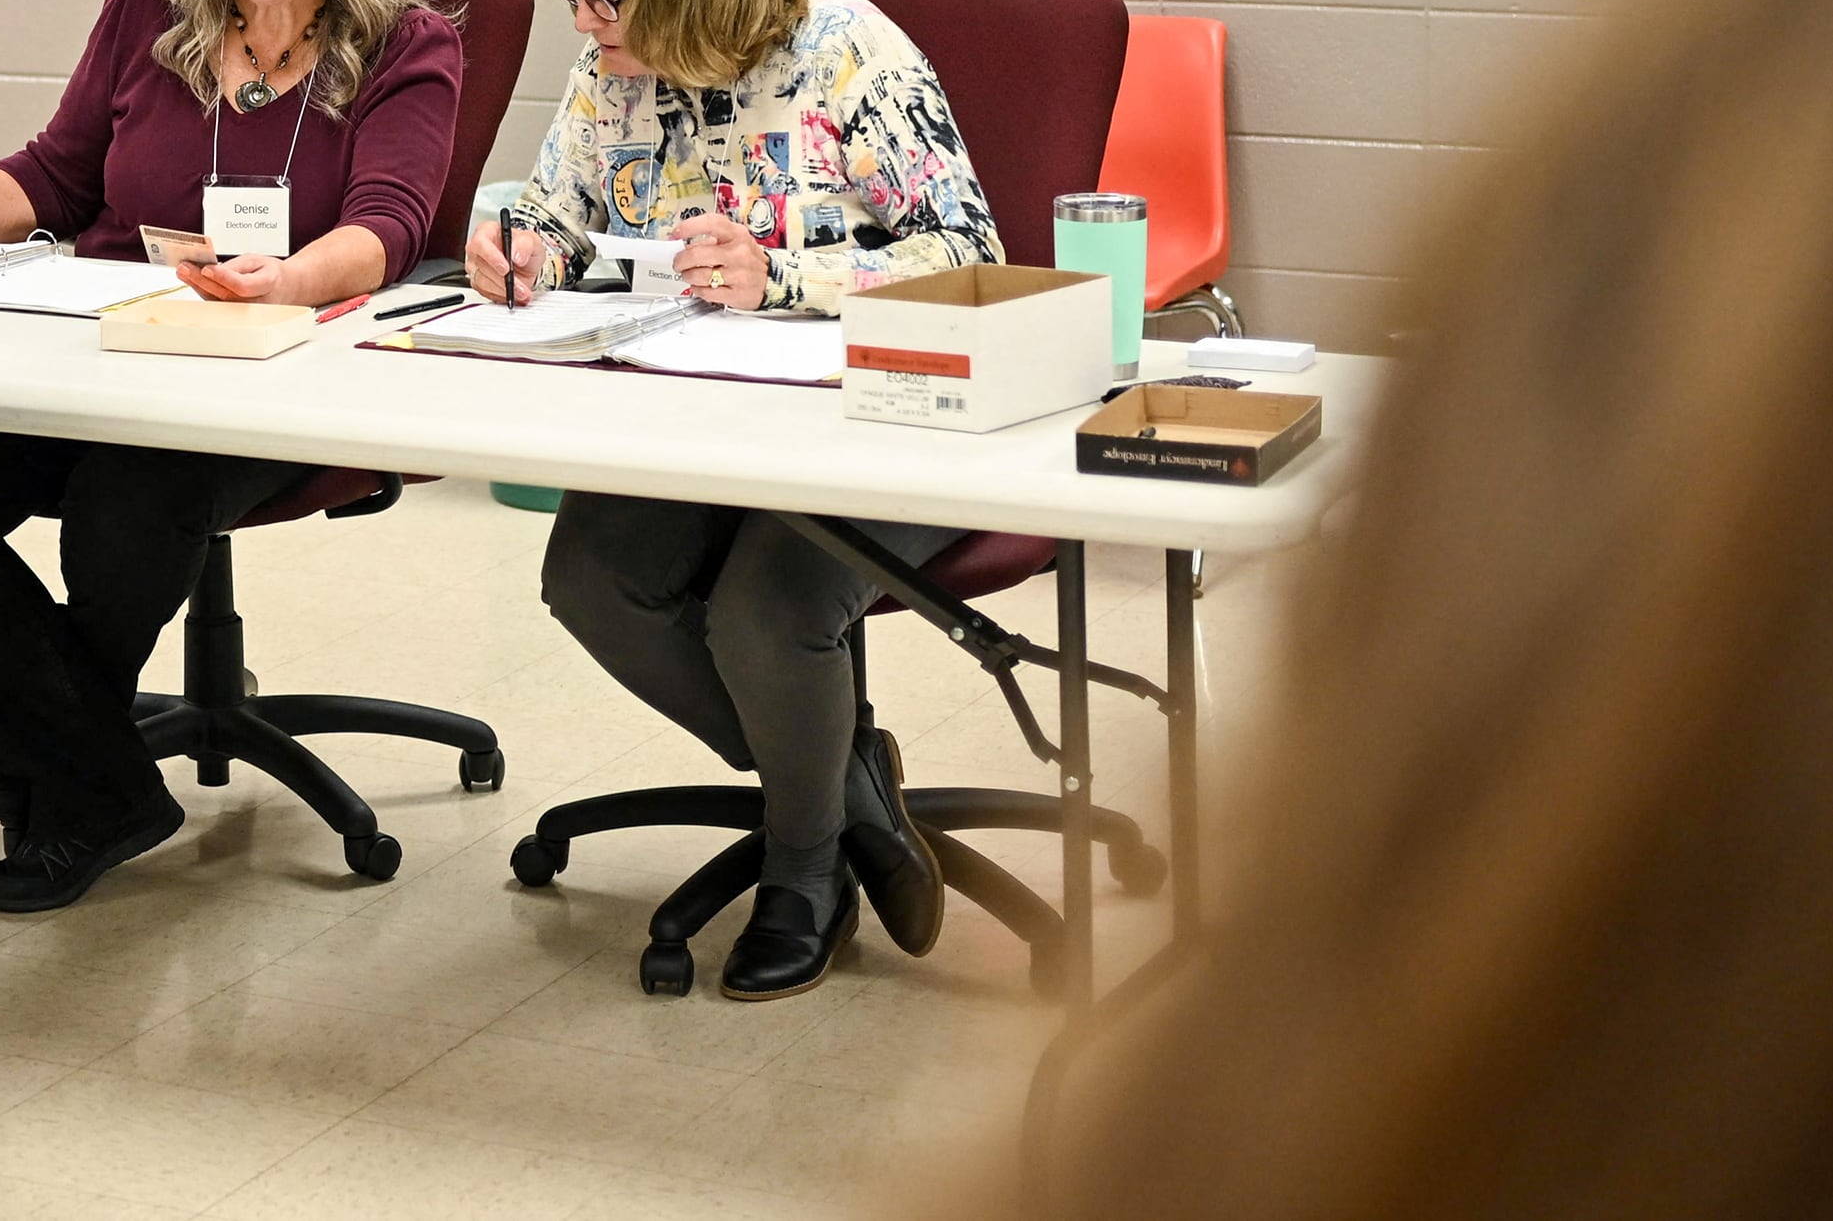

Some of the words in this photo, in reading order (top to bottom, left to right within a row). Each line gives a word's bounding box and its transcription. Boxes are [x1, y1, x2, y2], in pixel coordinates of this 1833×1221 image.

[234, 203, 270, 215] Denise
[225, 221, 253, 229] Election
[254, 221, 278, 229] Official
[648, 269, 673, 281] Election
